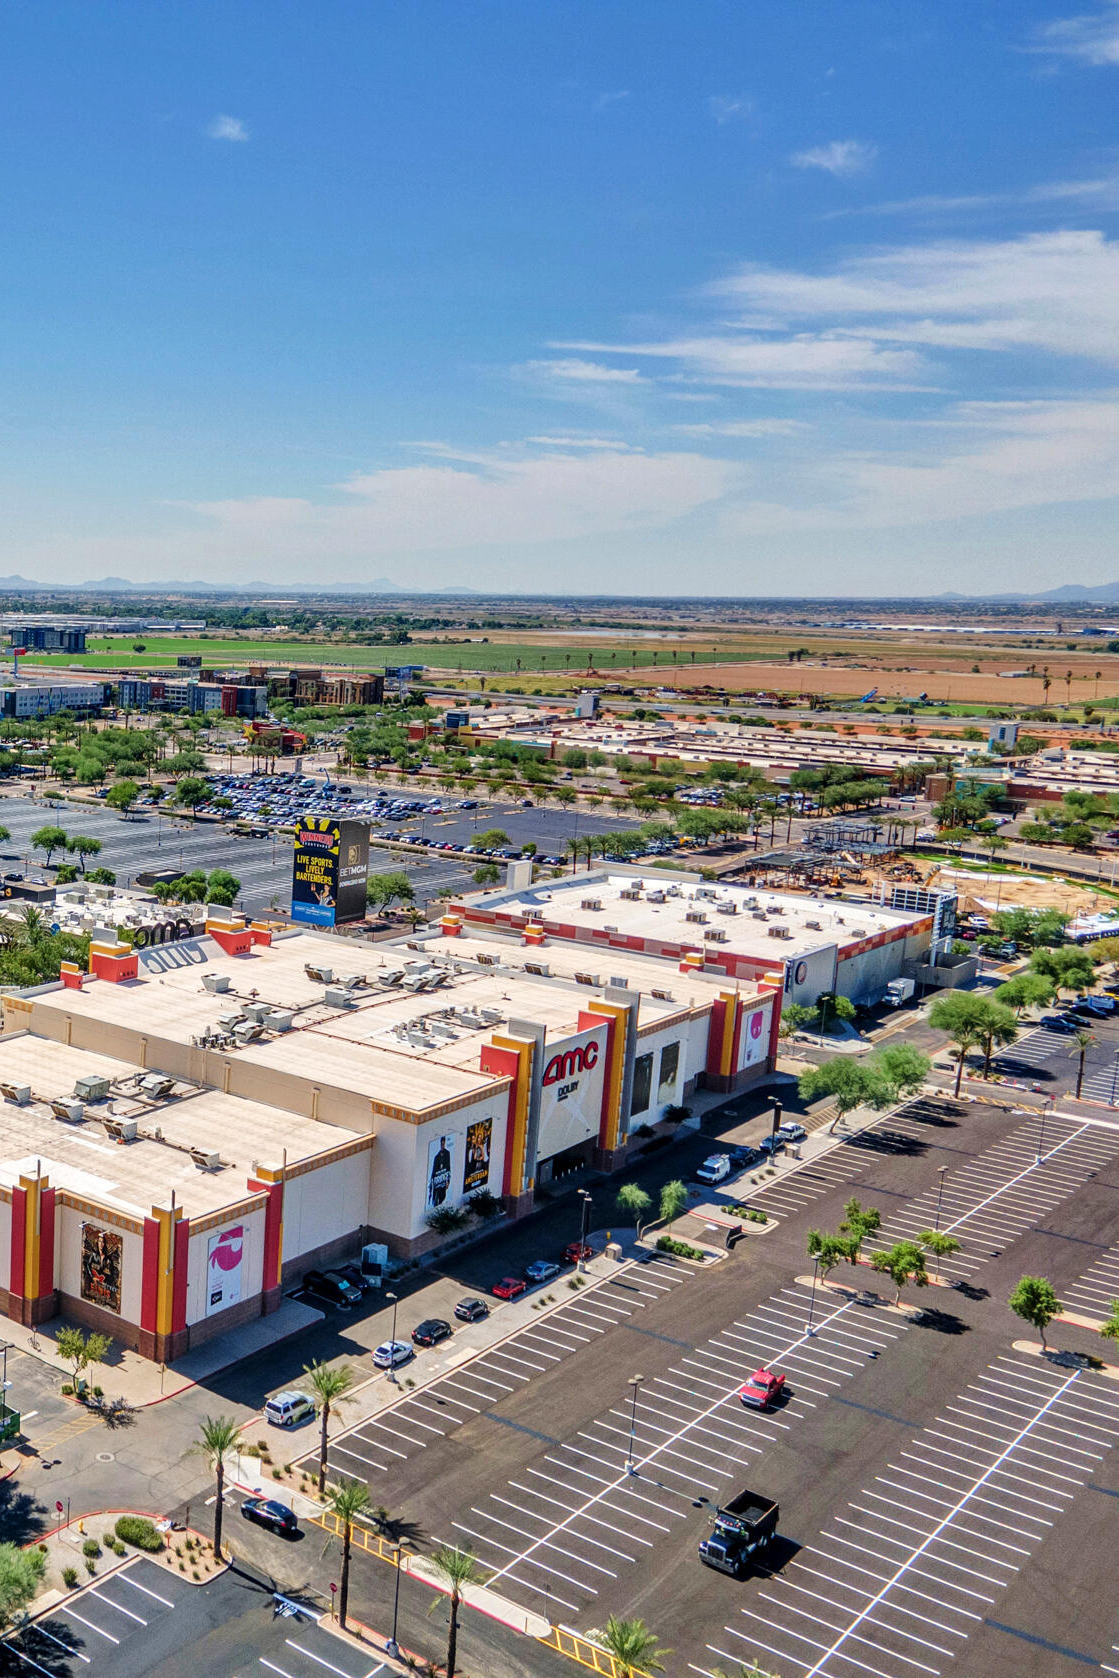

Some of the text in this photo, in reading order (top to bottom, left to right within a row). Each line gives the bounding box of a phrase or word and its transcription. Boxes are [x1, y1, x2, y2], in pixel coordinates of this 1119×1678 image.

[296, 854, 334, 868] LIVE SPORTS.
[305, 864, 325, 875] LIVELY
[557, 1080, 580, 1098] DOLBY
